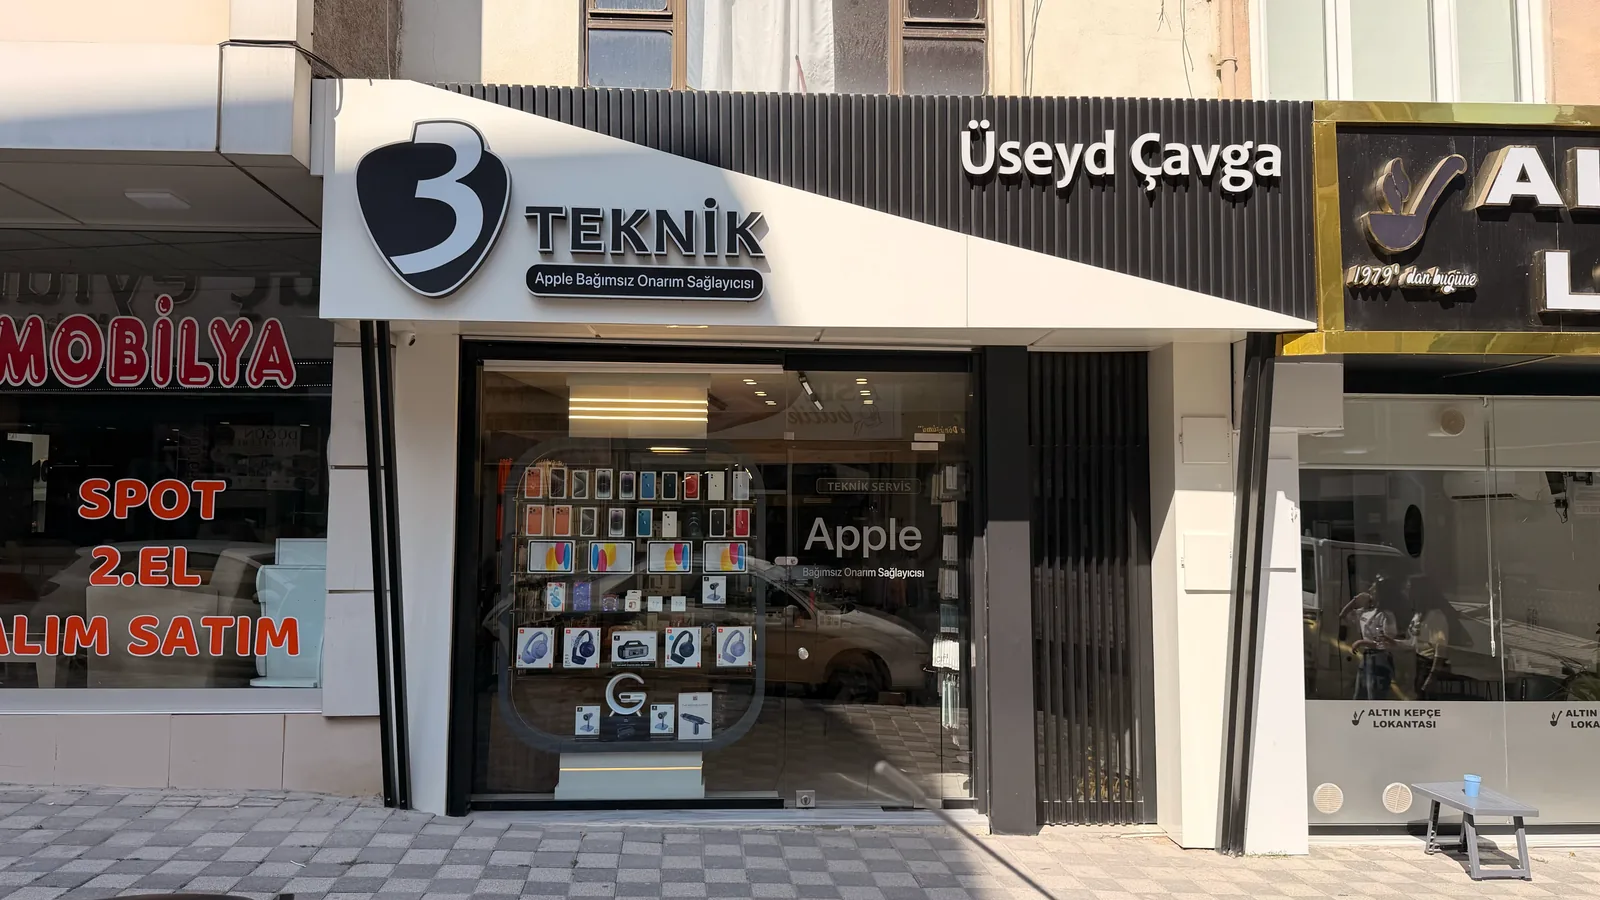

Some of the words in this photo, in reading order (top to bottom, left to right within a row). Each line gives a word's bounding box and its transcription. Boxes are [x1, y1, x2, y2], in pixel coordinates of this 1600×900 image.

[961, 120, 1114, 188] Üseyd
[1130, 133, 1281, 192] Çavga
[525, 198, 765, 257] TEKNİK
[535, 272, 573, 287] Apple
[576, 272, 634, 288] Bağımsız
[637, 274, 684, 288] Onarım
[687, 276, 755, 291] Sağlayıcısı
[0, 294, 296, 389] MOBİLYA
[78, 478, 226, 520] SPOT
[828, 480, 868, 491] TEKNİK
[871, 480, 911, 492] SERVİS
[804, 517, 922, 558] Apple
[89, 546, 201, 587] 2.EL
[802, 567, 842, 578] Bağımsız
[844, 567, 876, 577] Onarım
[878, 567, 925, 579] Sağlayıcısı
[0, 615, 109, 656] LIM
[128, 615, 300, 656] SATIM
[1368, 709, 1401, 717] ALTIN
[1404, 709, 1441, 719] KEPÇE
[1373, 720, 1436, 729] LOKANTASI
[1566, 709, 1598, 717] ALTIN
[1571, 720, 1600, 729] LOKA
